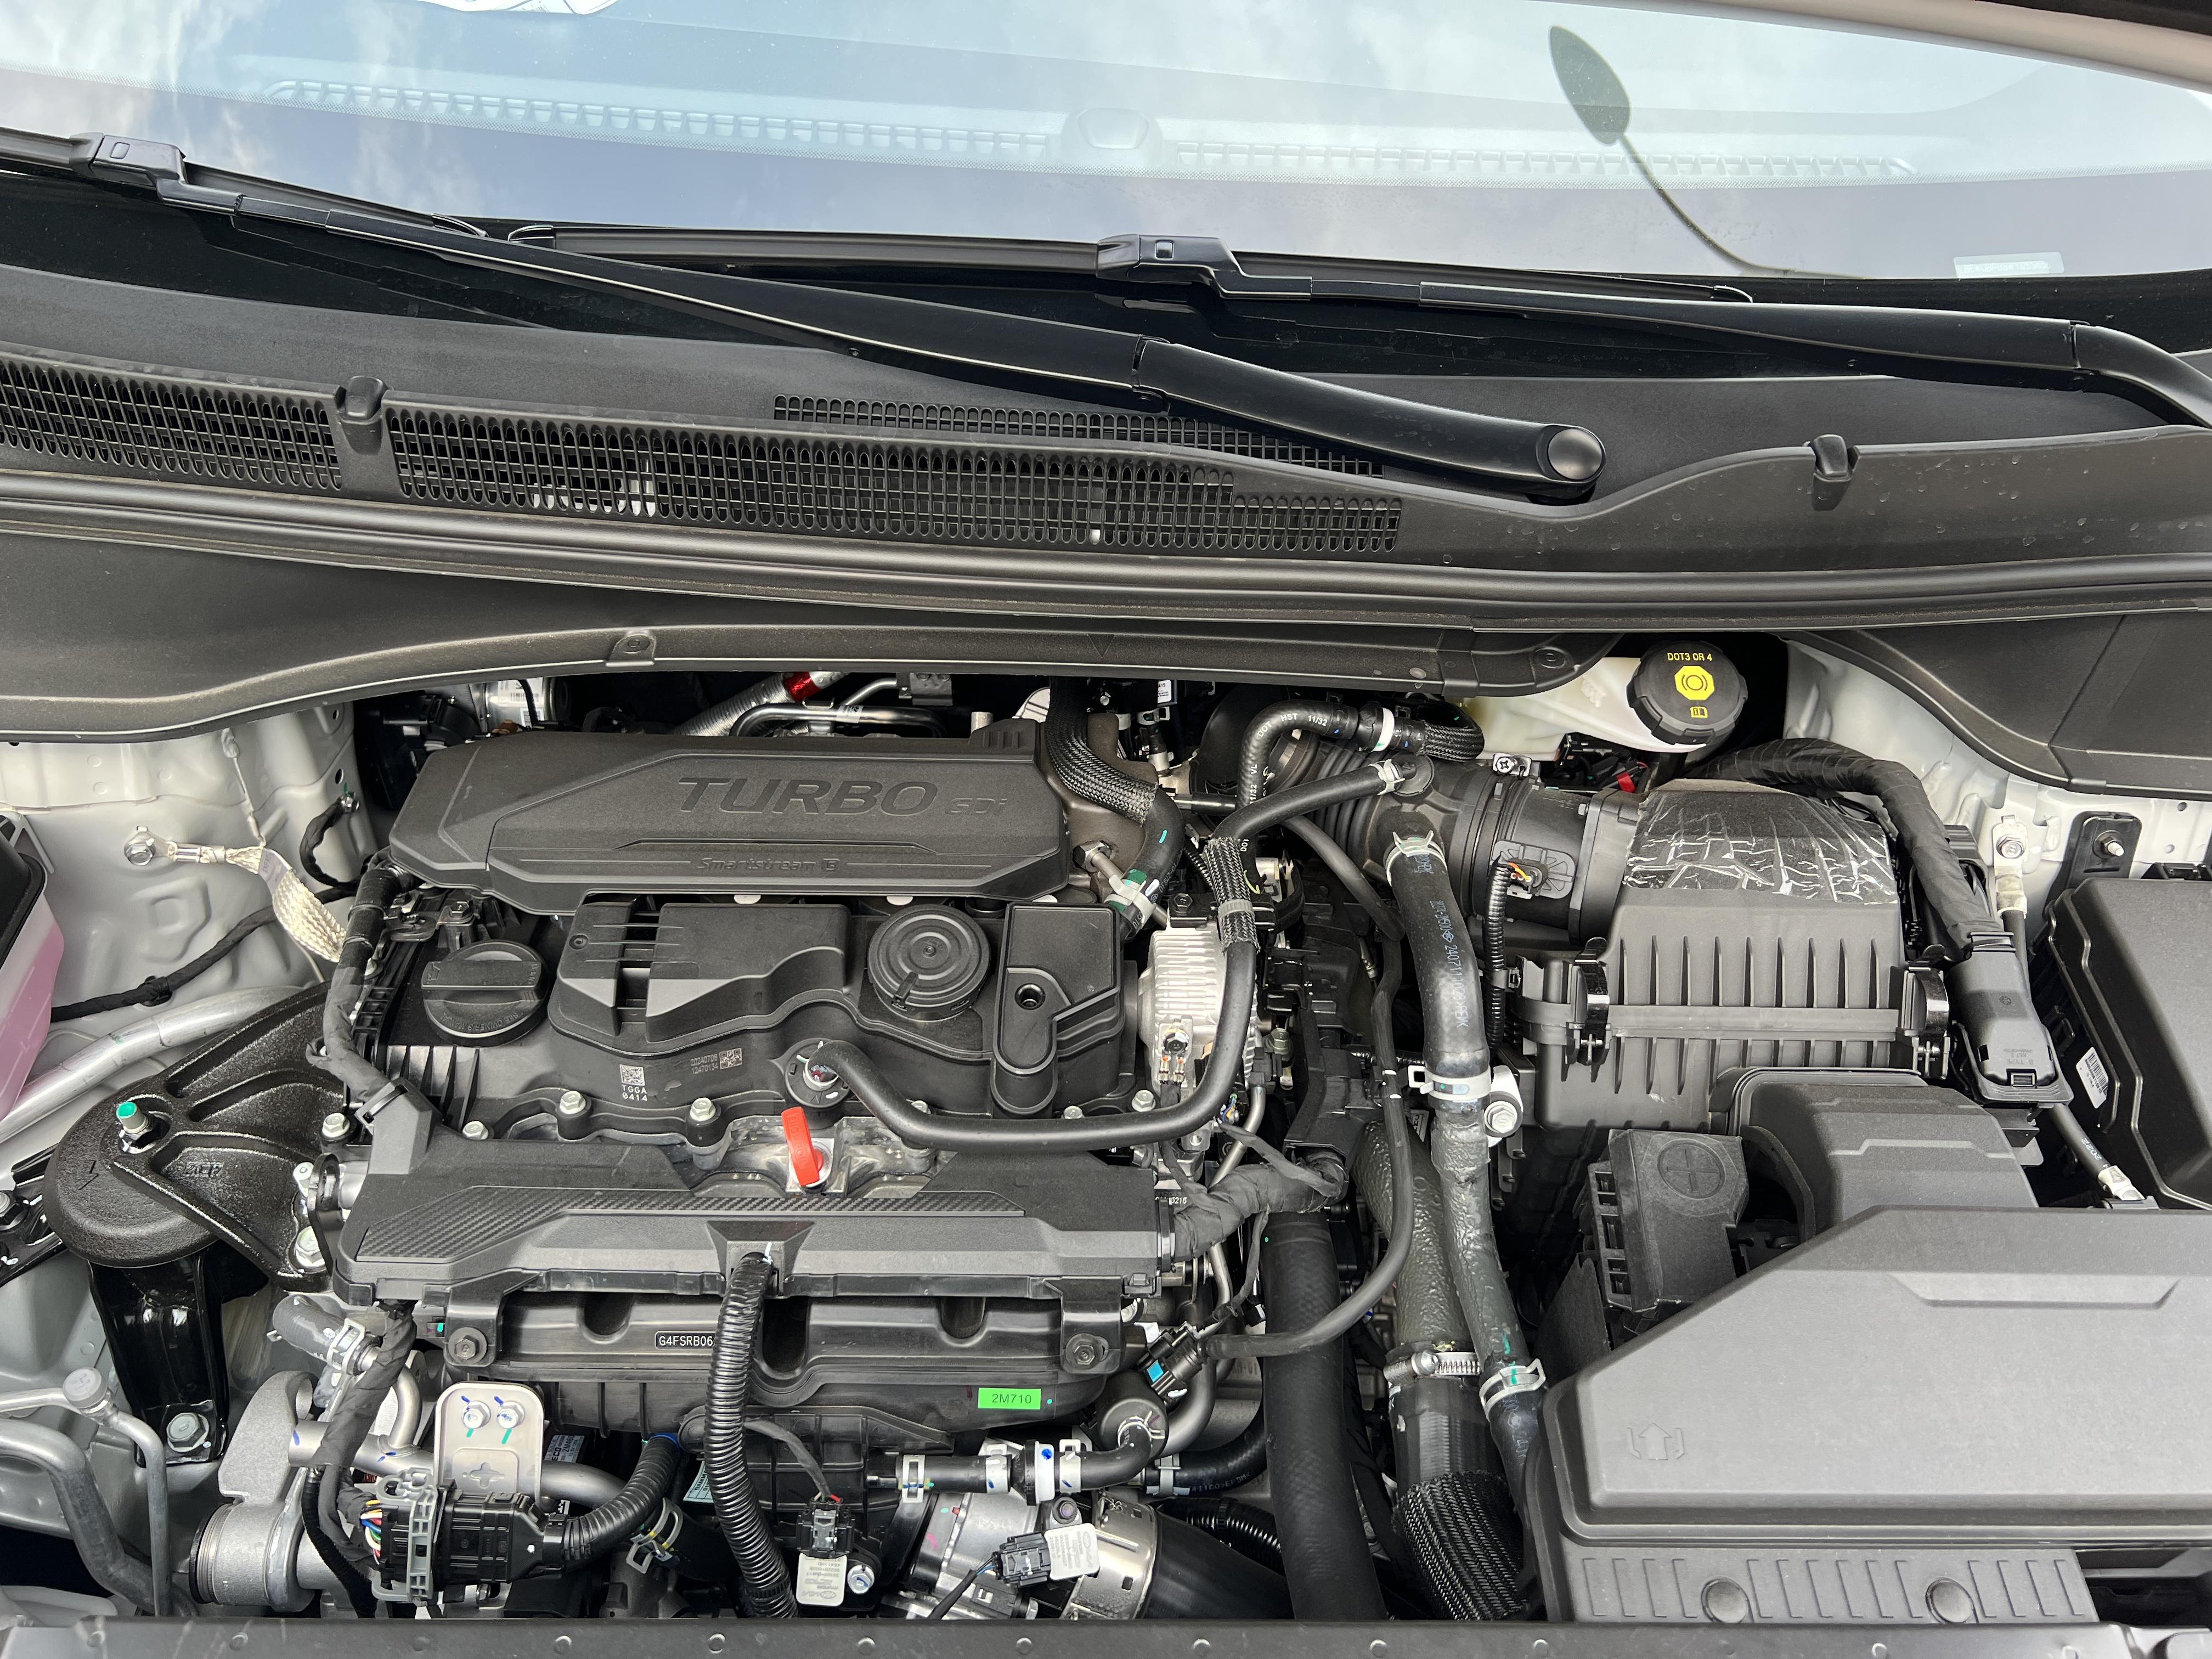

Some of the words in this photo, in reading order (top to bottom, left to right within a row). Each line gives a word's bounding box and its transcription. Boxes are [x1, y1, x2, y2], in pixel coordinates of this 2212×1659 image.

[1667, 652, 1690, 662] DOT3
[1692, 652, 1705, 662] OR
[1707, 653, 1712, 662] 4
[1257, 720, 1273, 737] DOT
[1280, 713, 1298, 722] HST
[1308, 715, 1328, 726] 11/32
[1250, 764, 1257, 775] VL
[678, 777, 938, 817] TURBO
[697, 857, 816, 872] Smartstream
[621, 1084, 647, 1094] TGGA
[622, 1092, 648, 1102] 0414
[991, 1393, 1032, 1404] 2M710
